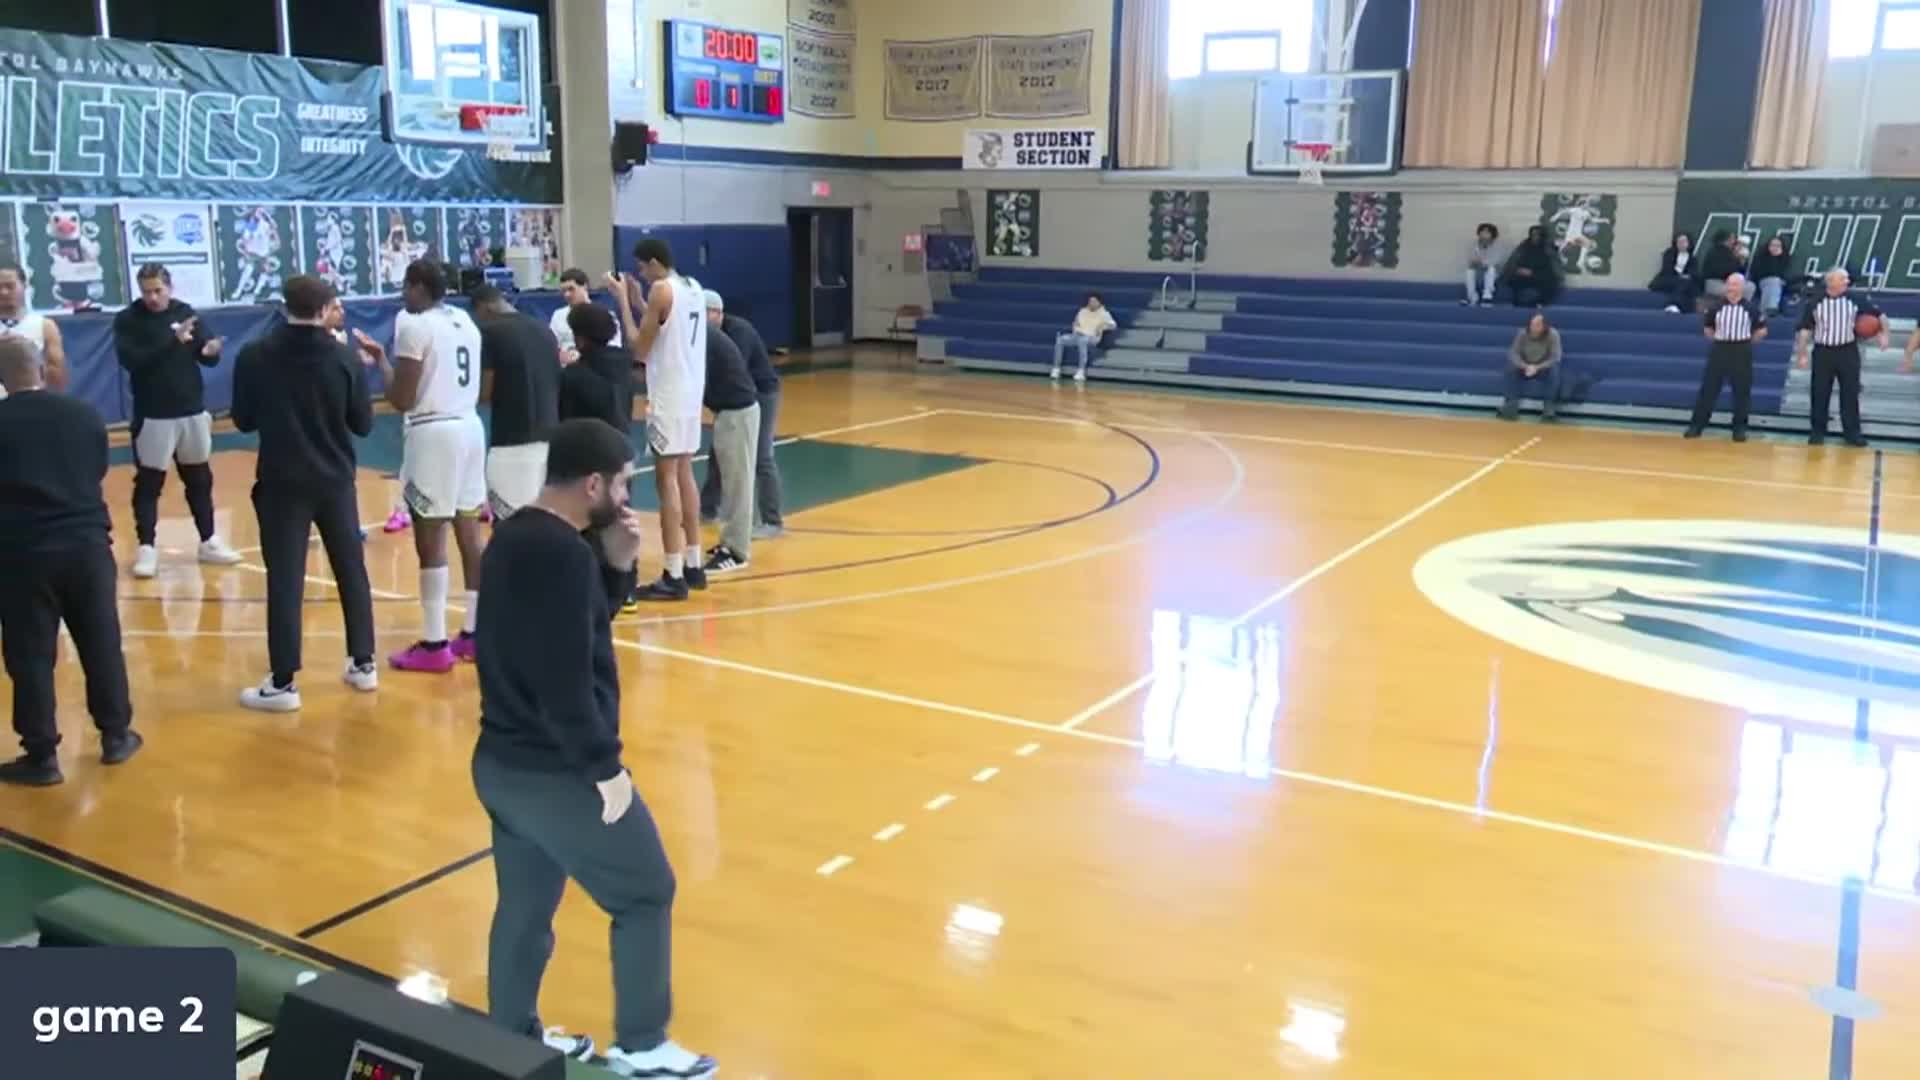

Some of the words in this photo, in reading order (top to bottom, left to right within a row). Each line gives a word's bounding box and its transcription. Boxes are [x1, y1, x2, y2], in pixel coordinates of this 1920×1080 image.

[704, 29, 755, 63] 20:00
[297, 103, 368, 122] GREATNESS
[0, 75, 281, 182] LETICS
[1013, 131, 1095, 147] STUDENT
[301, 136, 368, 155] INTEGRITY
[1016, 149, 1091, 165] SECTION
[689, 311, 699, 347] 7
[456, 346, 470, 387] 9
